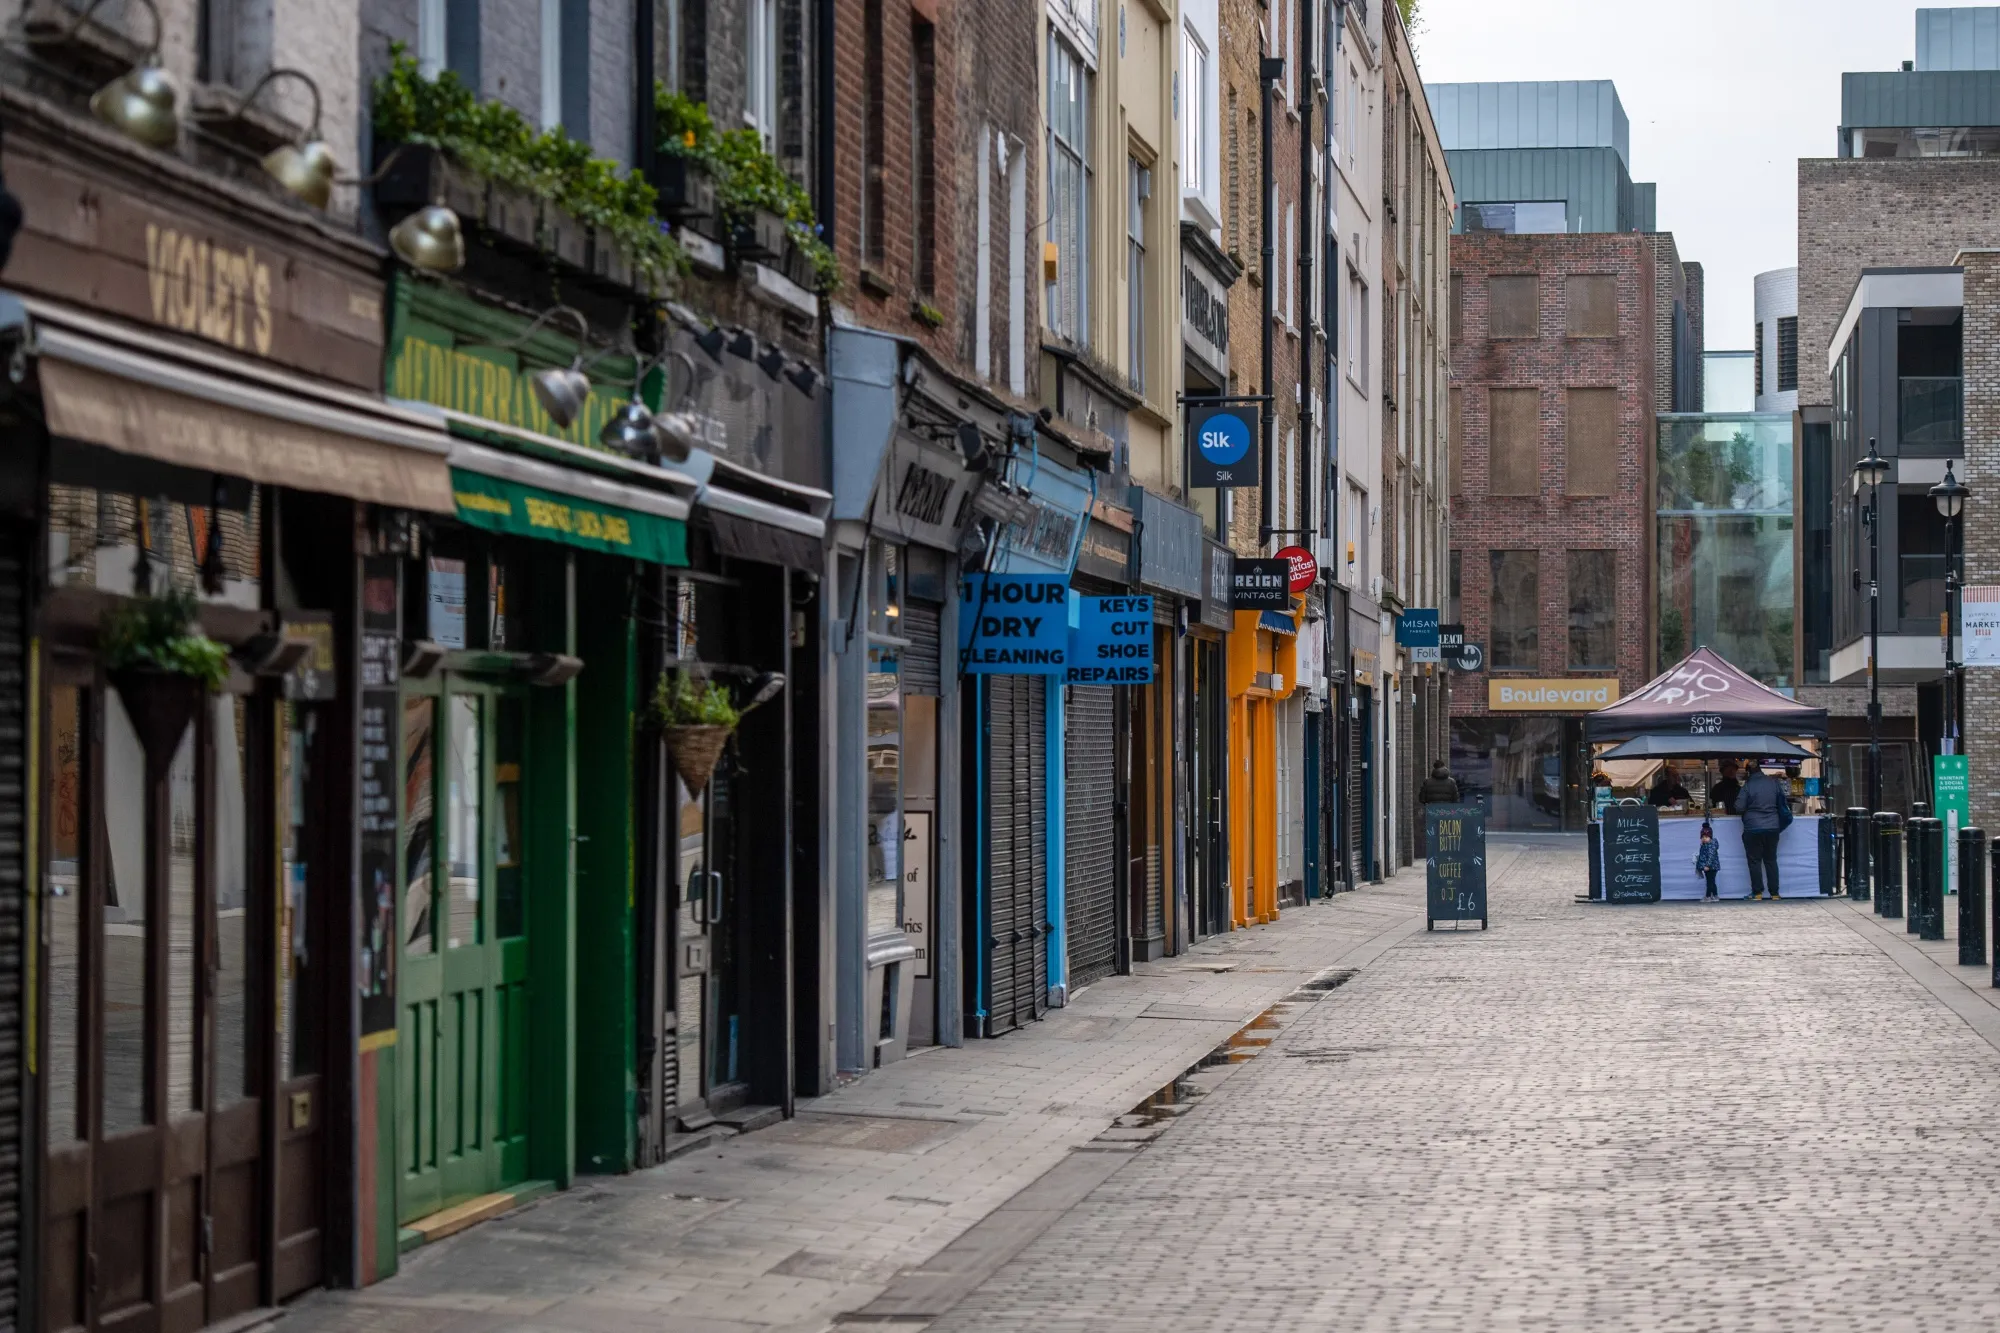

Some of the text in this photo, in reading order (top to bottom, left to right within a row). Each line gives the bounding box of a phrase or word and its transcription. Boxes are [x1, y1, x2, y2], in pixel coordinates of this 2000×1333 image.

[145, 223, 273, 356] VIOLET'S
[1216, 471, 1233, 481] Silk
[1290, 560, 1314, 573] akfast
[1235, 575, 1282, 588] REIGN
[1290, 572, 1302, 582] ub
[964, 583, 1065, 604] 1 HOUR
[1235, 592, 1282, 600] VINTAGE
[1100, 599, 1149, 613] KEYS
[982, 617, 1042, 637] DRY
[1111, 621, 1149, 635] CUT
[1402, 620, 1438, 628] MISAN
[1965, 621, 2000, 629] MARKET
[1438, 634, 1463, 645] LEACH
[960, 649, 1064, 664] CLEANING
[1097, 644, 1149, 658] SHOE
[1416, 648, 1438, 658] Folk
[1067, 667, 1149, 682] REPAIRS
[1500, 687, 1608, 703] Boulevard
[1691, 716, 1722, 726] SOHO
[1691, 726, 1722, 734] DAIRY
[1439, 820, 1462, 836] BACON
[1616, 818, 1648, 828] MILK
[1439, 836, 1462, 851] BUTTY
[1616, 834, 1652, 844] EGGS
[1615, 853, 1652, 863] CHEESE
[907, 868, 919, 882] of
[1439, 862, 1462, 878] COFFEE
[1615, 875, 1652, 883] COFFEE
